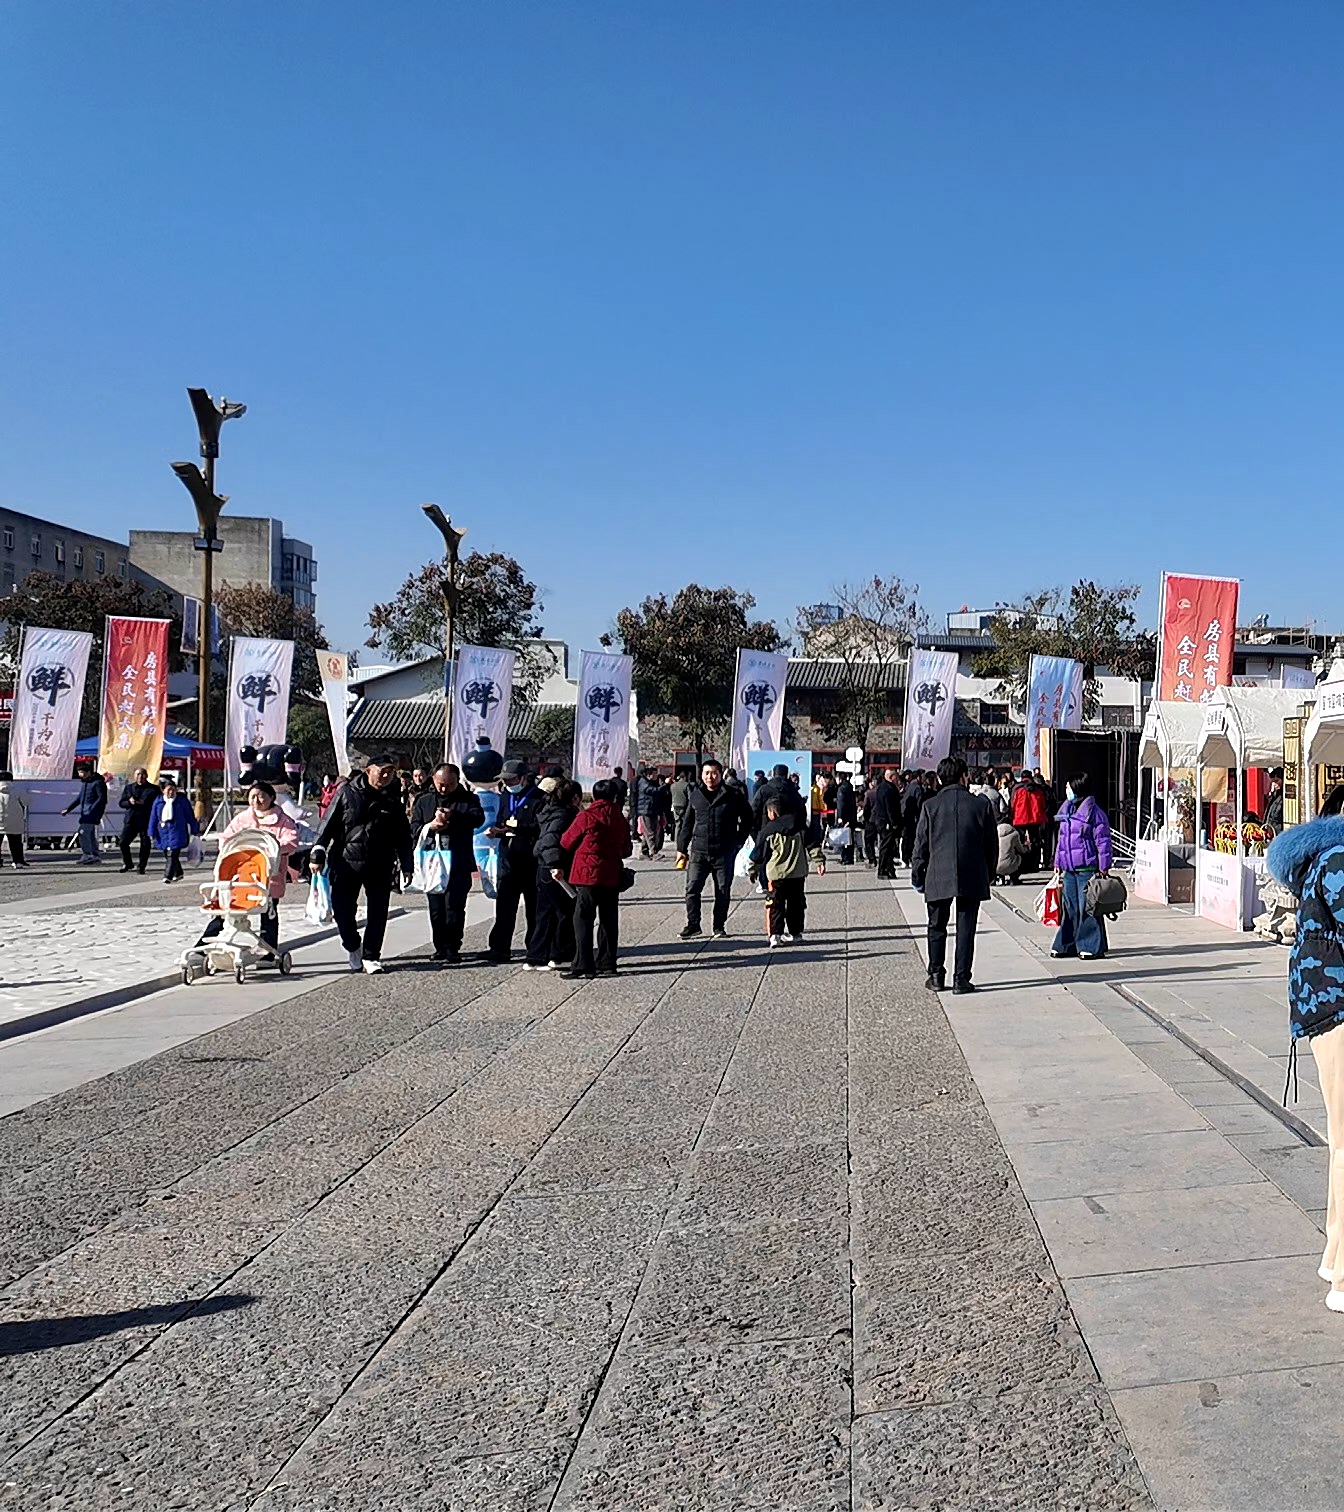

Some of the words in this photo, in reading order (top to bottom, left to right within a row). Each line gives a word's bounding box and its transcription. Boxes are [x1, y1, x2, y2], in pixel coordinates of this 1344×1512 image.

[30, 666, 71, 707] 鲜
[139, 651, 158, 736] 房县有好物
[241, 674, 278, 714] 鲜
[464, 681, 500, 720] 鲜
[588, 686, 621, 724] 鲜
[744, 683, 774, 720] 鲜
[917, 682, 945, 716] 鲜
[114, 664, 140, 750] 全民赶大集
